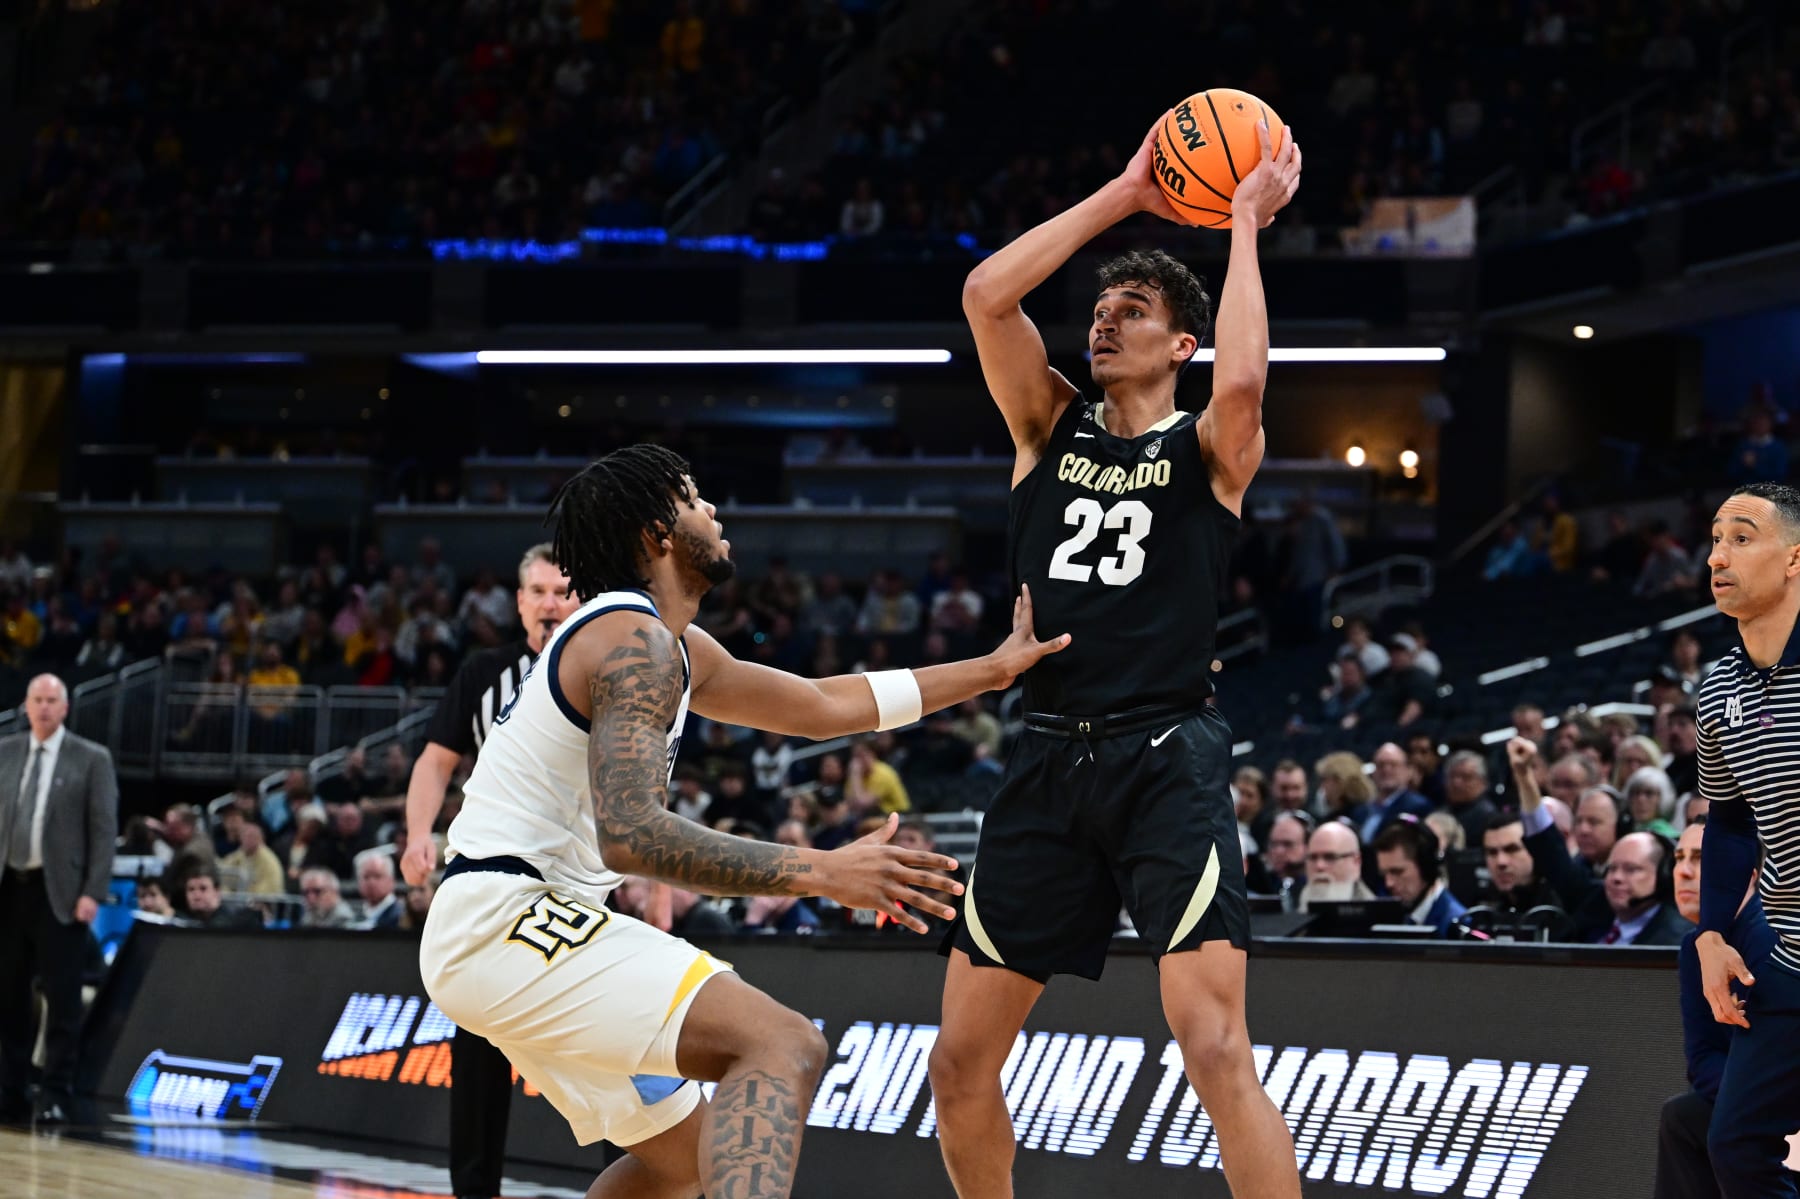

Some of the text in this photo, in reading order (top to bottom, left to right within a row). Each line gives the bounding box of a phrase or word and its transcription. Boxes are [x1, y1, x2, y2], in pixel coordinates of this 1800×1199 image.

[1057, 452, 1172, 495] COLORADO
[1048, 497, 1153, 586] 23
[1724, 694, 1744, 728] MU
[504, 892, 611, 965] MU
